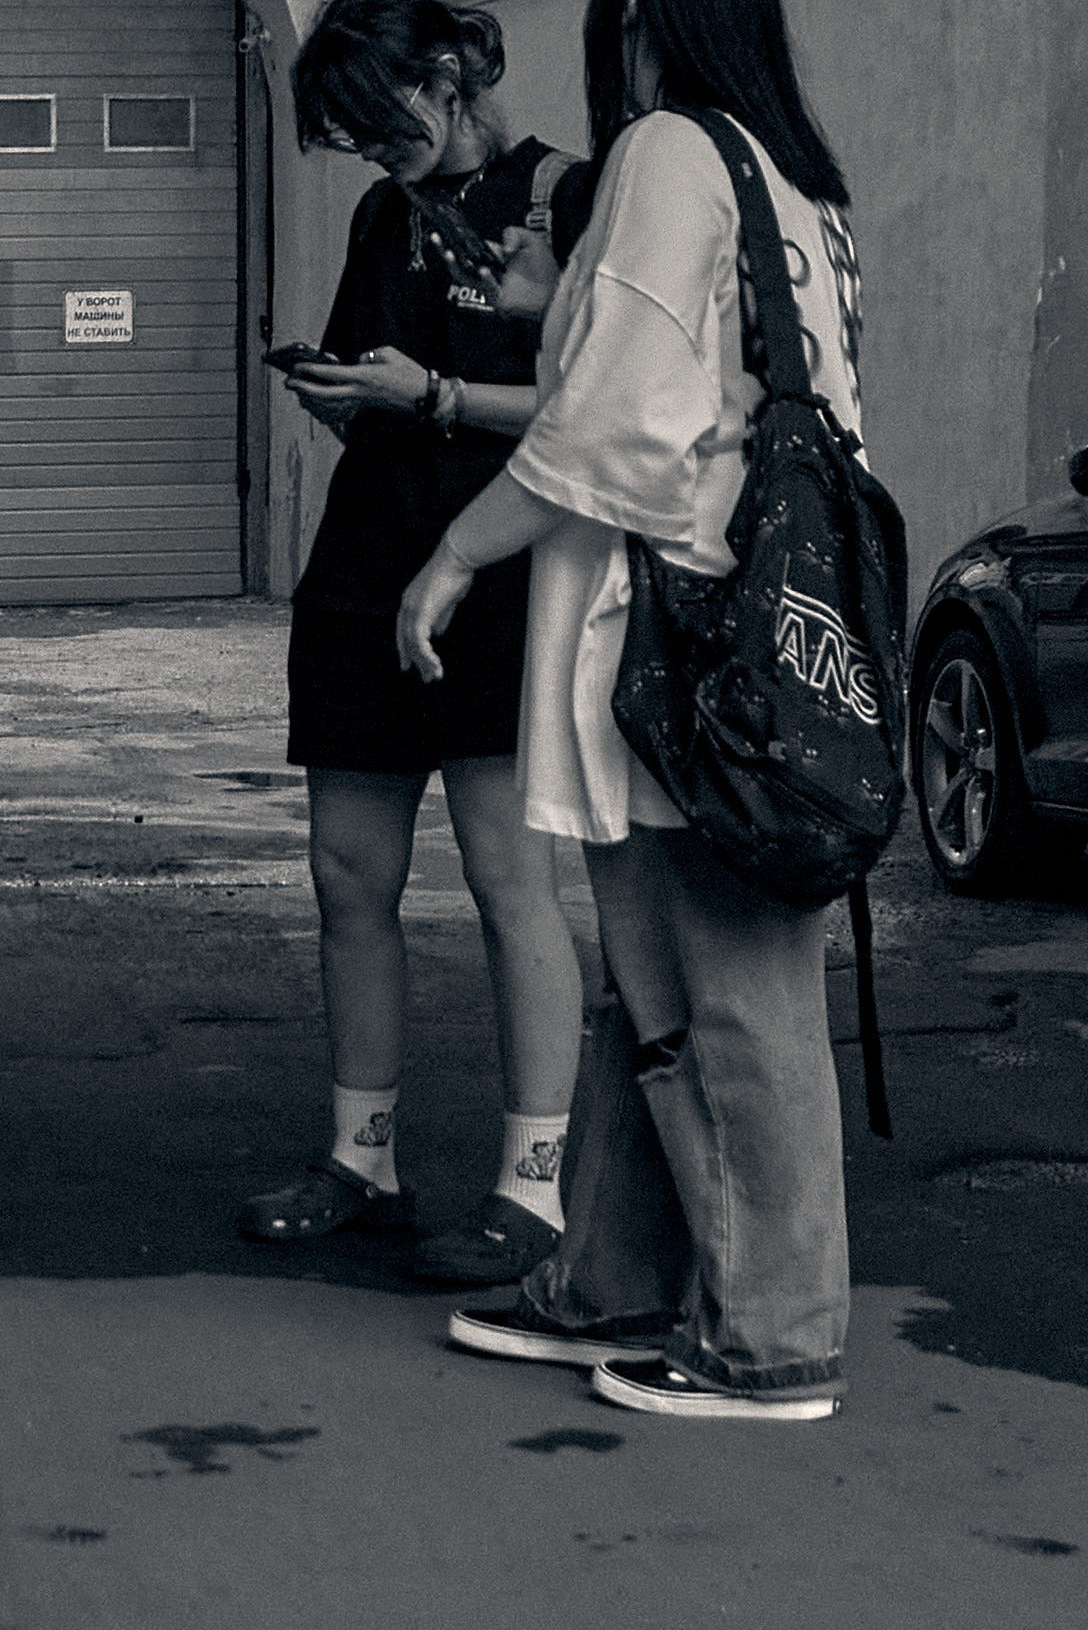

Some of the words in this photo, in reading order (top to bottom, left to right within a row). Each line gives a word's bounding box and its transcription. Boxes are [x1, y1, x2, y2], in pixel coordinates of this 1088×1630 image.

[77, 297, 85, 307] У
[86, 297, 122, 307] ВОРОТ
[74, 311, 125, 321] МАШИНЫ
[67, 328, 81, 337] НЕ
[83, 327, 131, 337] СТАВИТЬ
[775, 583, 882, 726] ANS
